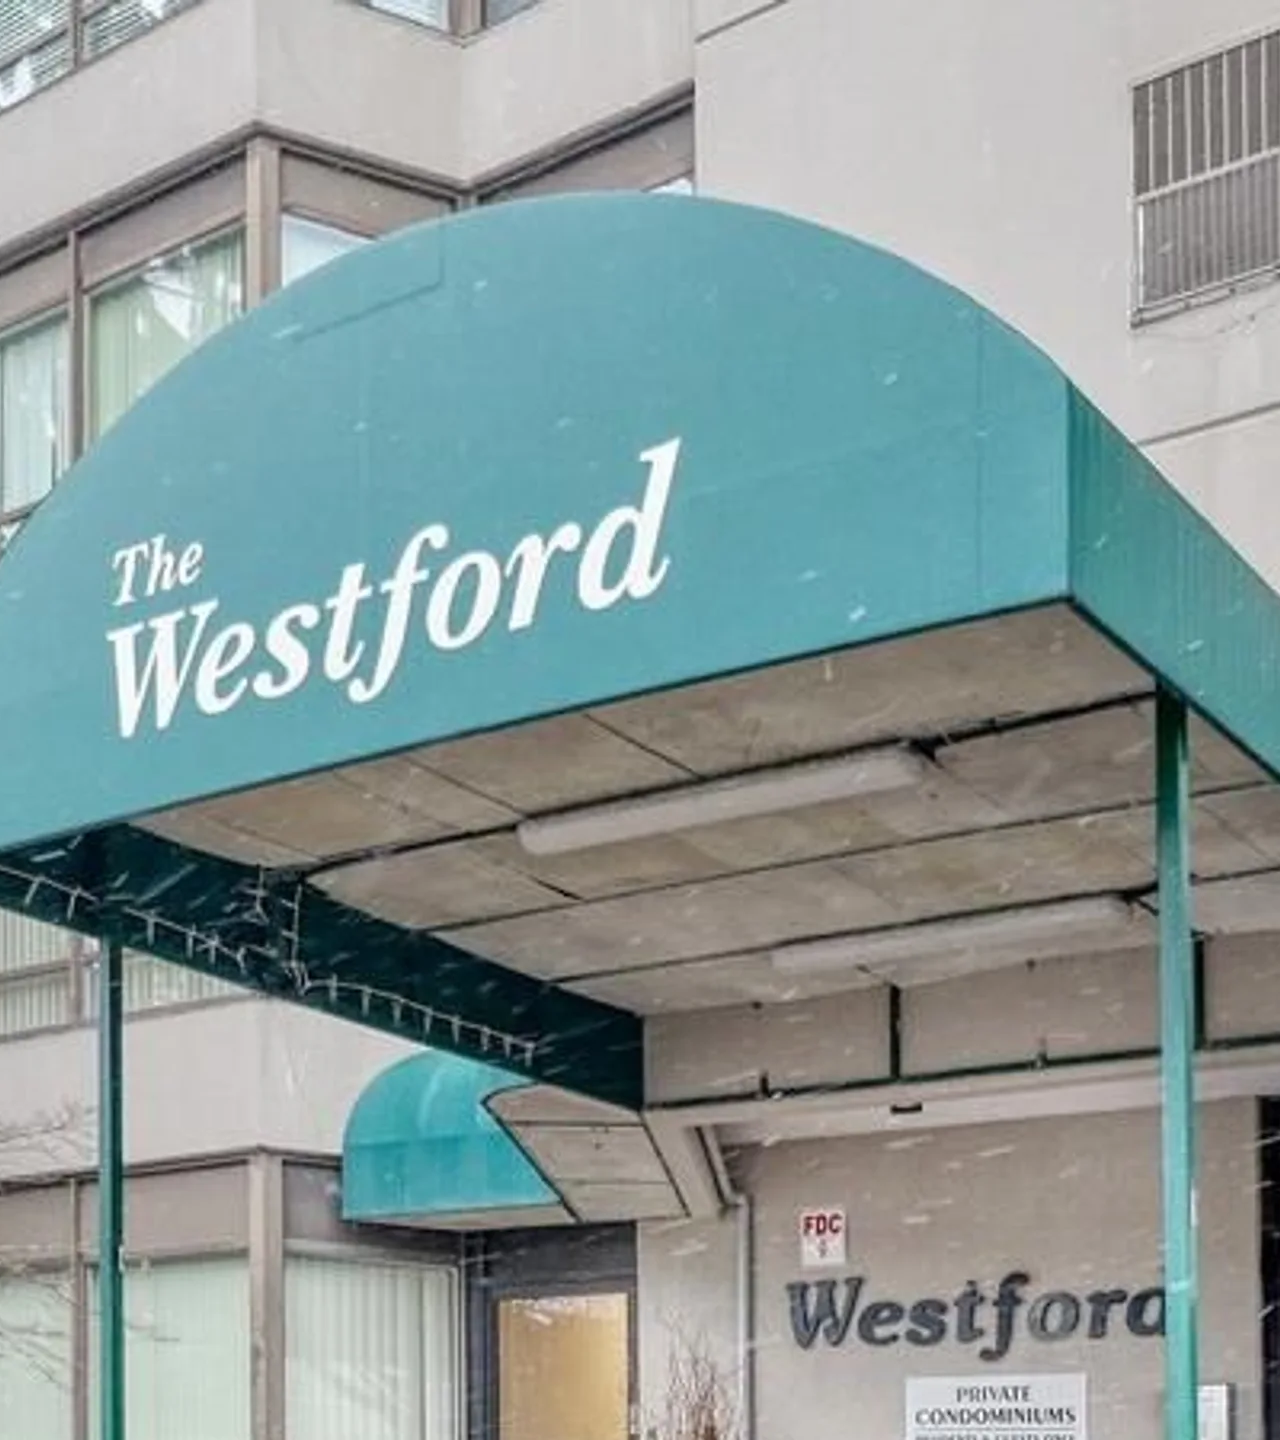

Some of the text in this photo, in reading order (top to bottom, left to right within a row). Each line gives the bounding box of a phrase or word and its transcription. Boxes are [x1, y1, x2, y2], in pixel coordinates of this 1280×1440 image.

[111, 533, 204, 606] The
[106, 437, 682, 738] Westford
[803, 1212, 843, 1236] FDC
[956, 1386, 1032, 1402] PRIVATE
[915, 1408, 1077, 1425] CONDOMINIUMS
